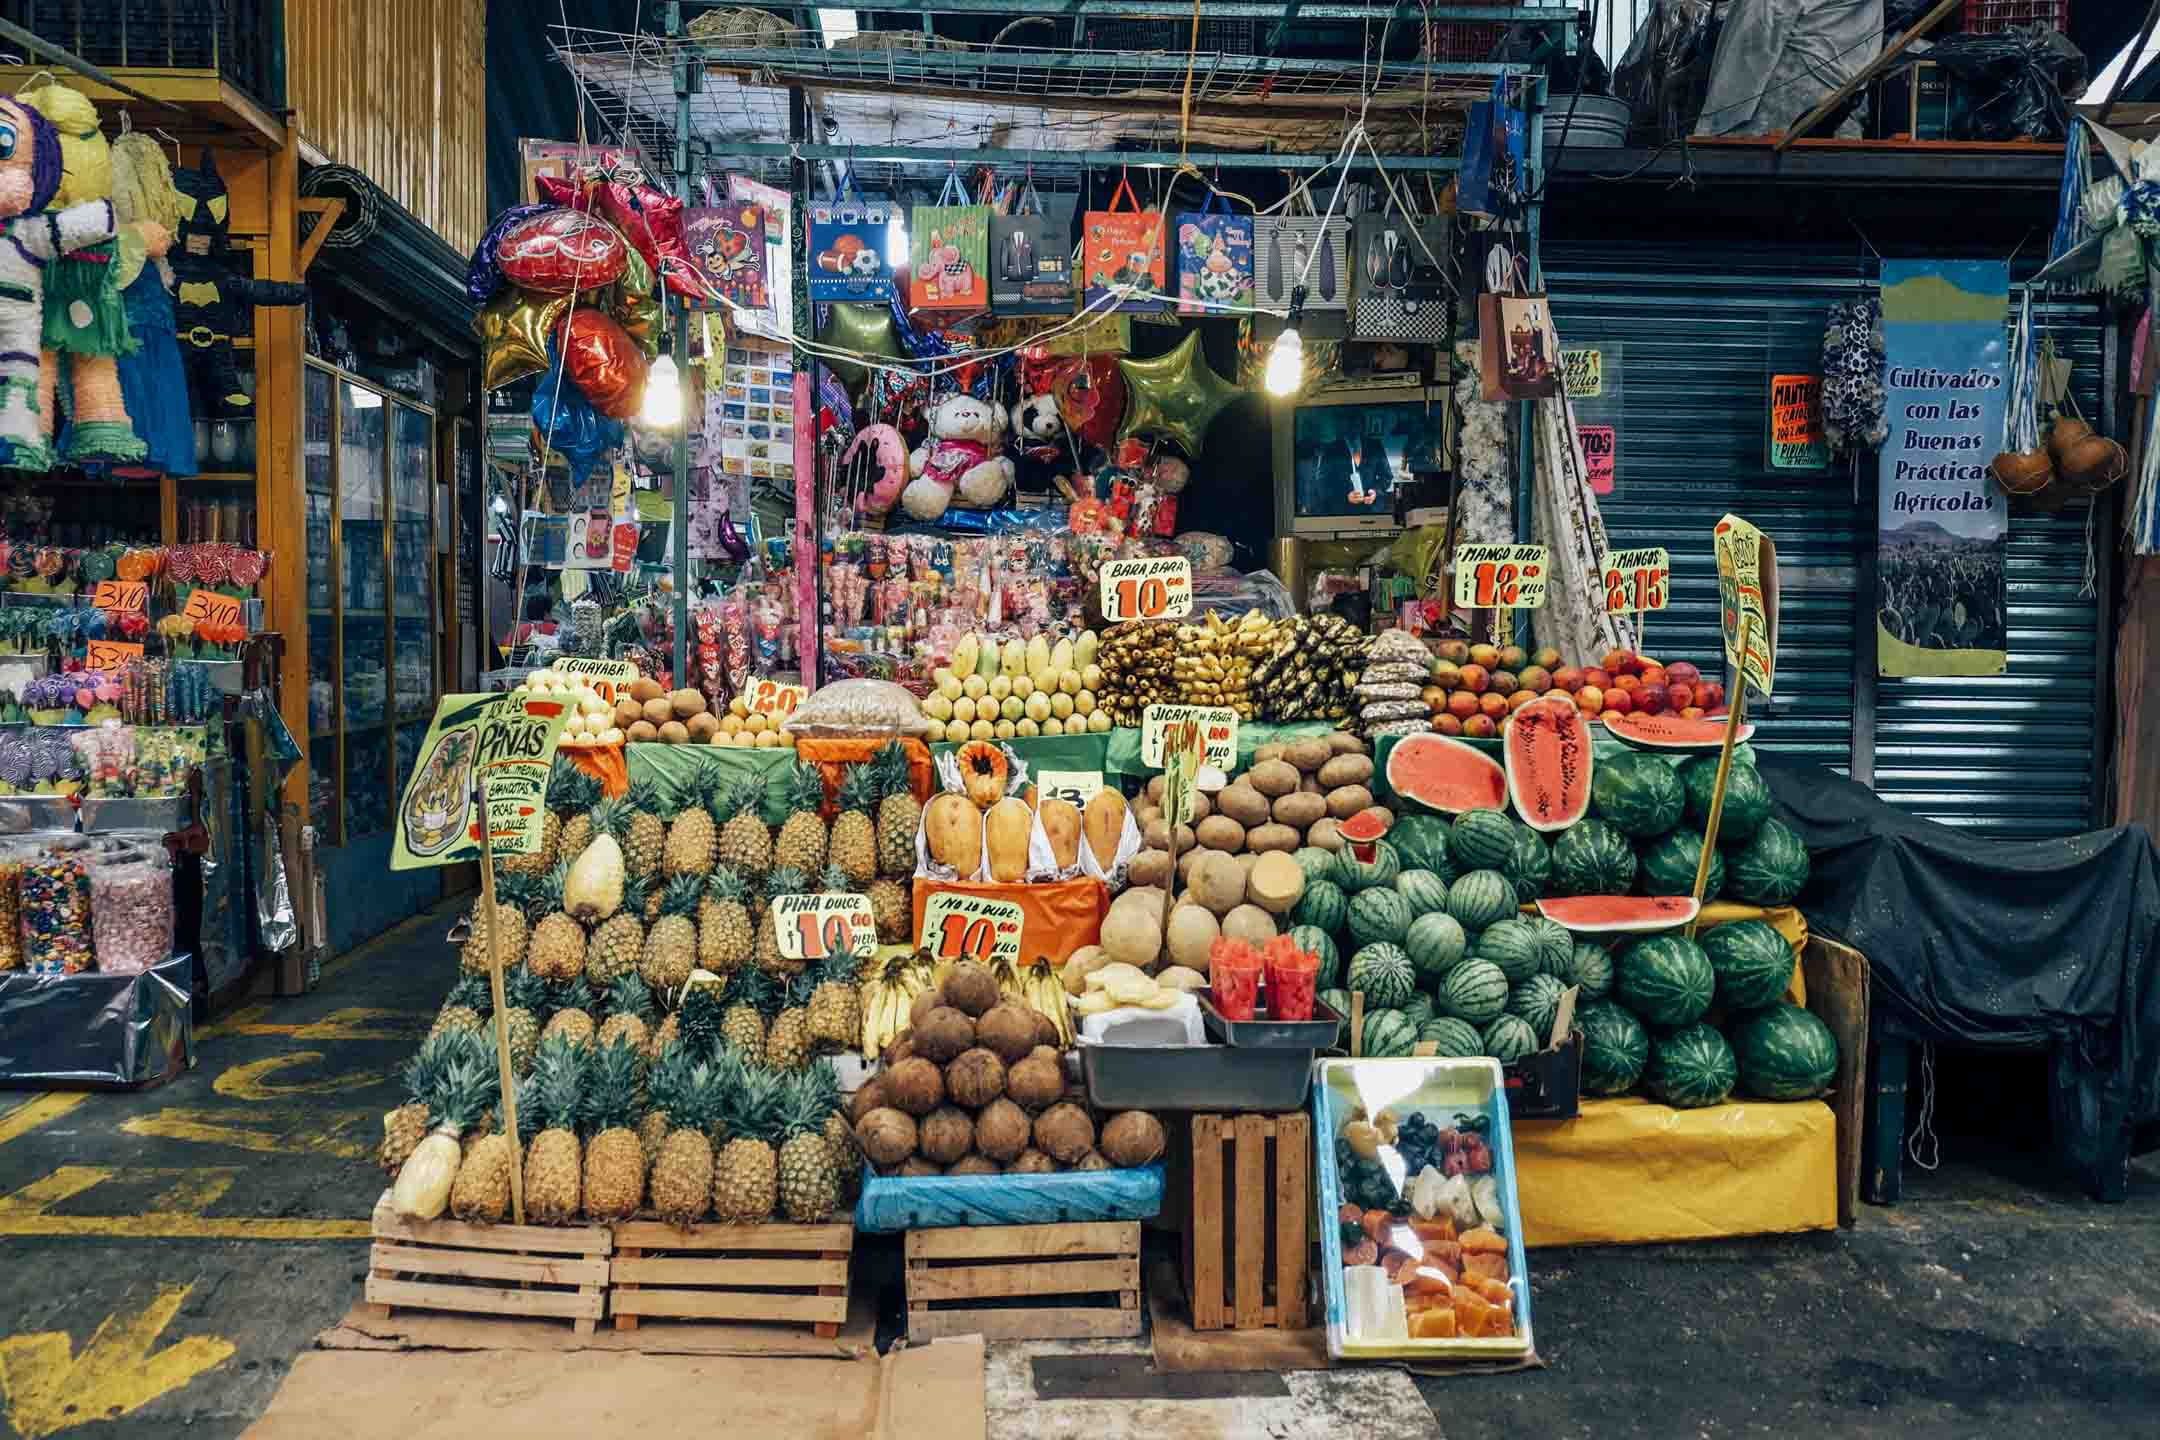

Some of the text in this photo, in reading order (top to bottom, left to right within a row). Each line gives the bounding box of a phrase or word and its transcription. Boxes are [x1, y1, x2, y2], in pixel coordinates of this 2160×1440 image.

[1889, 367, 2001, 389] Cultivados
[1905, 400, 1981, 419] con las
[1903, 430, 1983, 450] Buenas
[1895, 460, 1992, 481] Prácticas
[1892, 490, 1994, 514] Agrícolas
[96, 583, 145, 608] 3X10
[1115, 579, 1167, 618] 10
[1473, 563, 1519, 606] 12
[1634, 569, 1663, 609] 15
[754, 682, 798, 714] 20
[472, 720, 551, 768] PIÑAS
[780, 895, 861, 914] PIÑA DULCE
[796, 913, 854, 958] 10
[938, 913, 996, 961] 10
